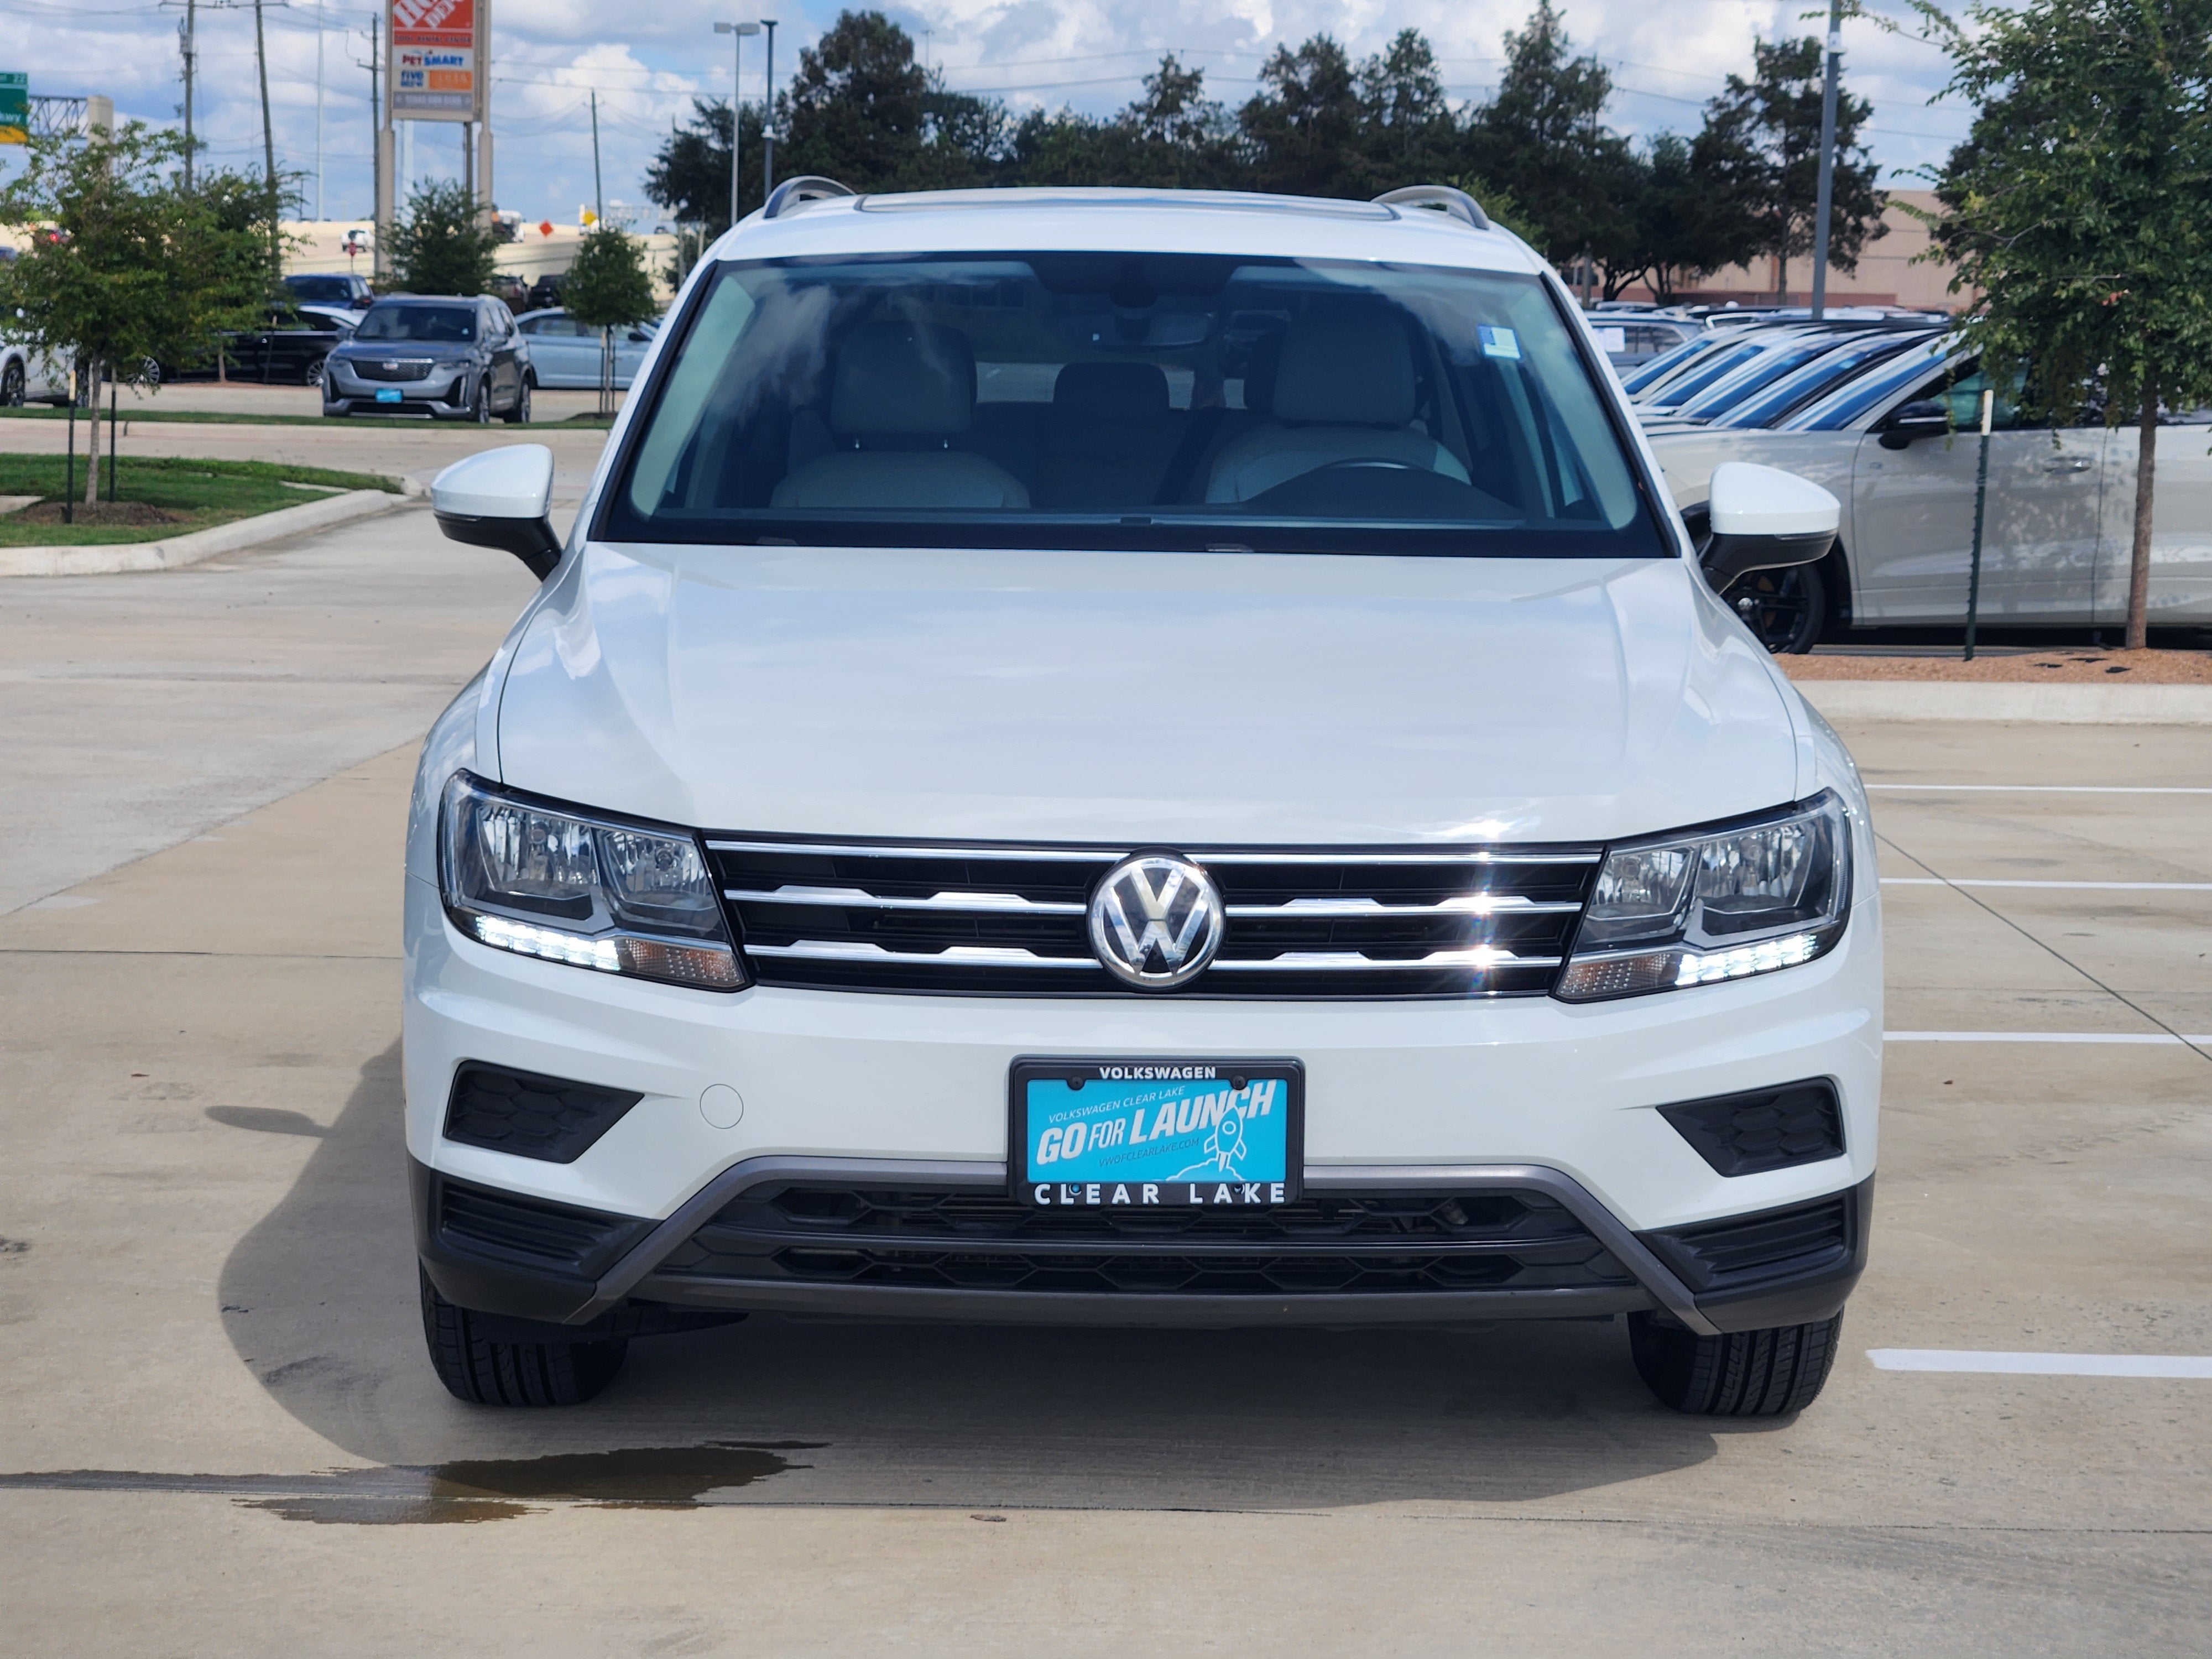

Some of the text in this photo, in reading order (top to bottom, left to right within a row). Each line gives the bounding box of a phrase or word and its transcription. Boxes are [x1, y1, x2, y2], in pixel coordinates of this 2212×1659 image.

[1099, 1067, 1216, 1079] VOLKSWAGEN
[1048, 1086, 1185, 1123] VOLKSWAGEN CLEAR LAKE
[1036, 1079, 1277, 1165] GO FOR LAUNCH
[1099, 1138, 1200, 1167] VWOFCLEARLAKE.COM
[1034, 1182, 1286, 1205] CLEAR LAKE
